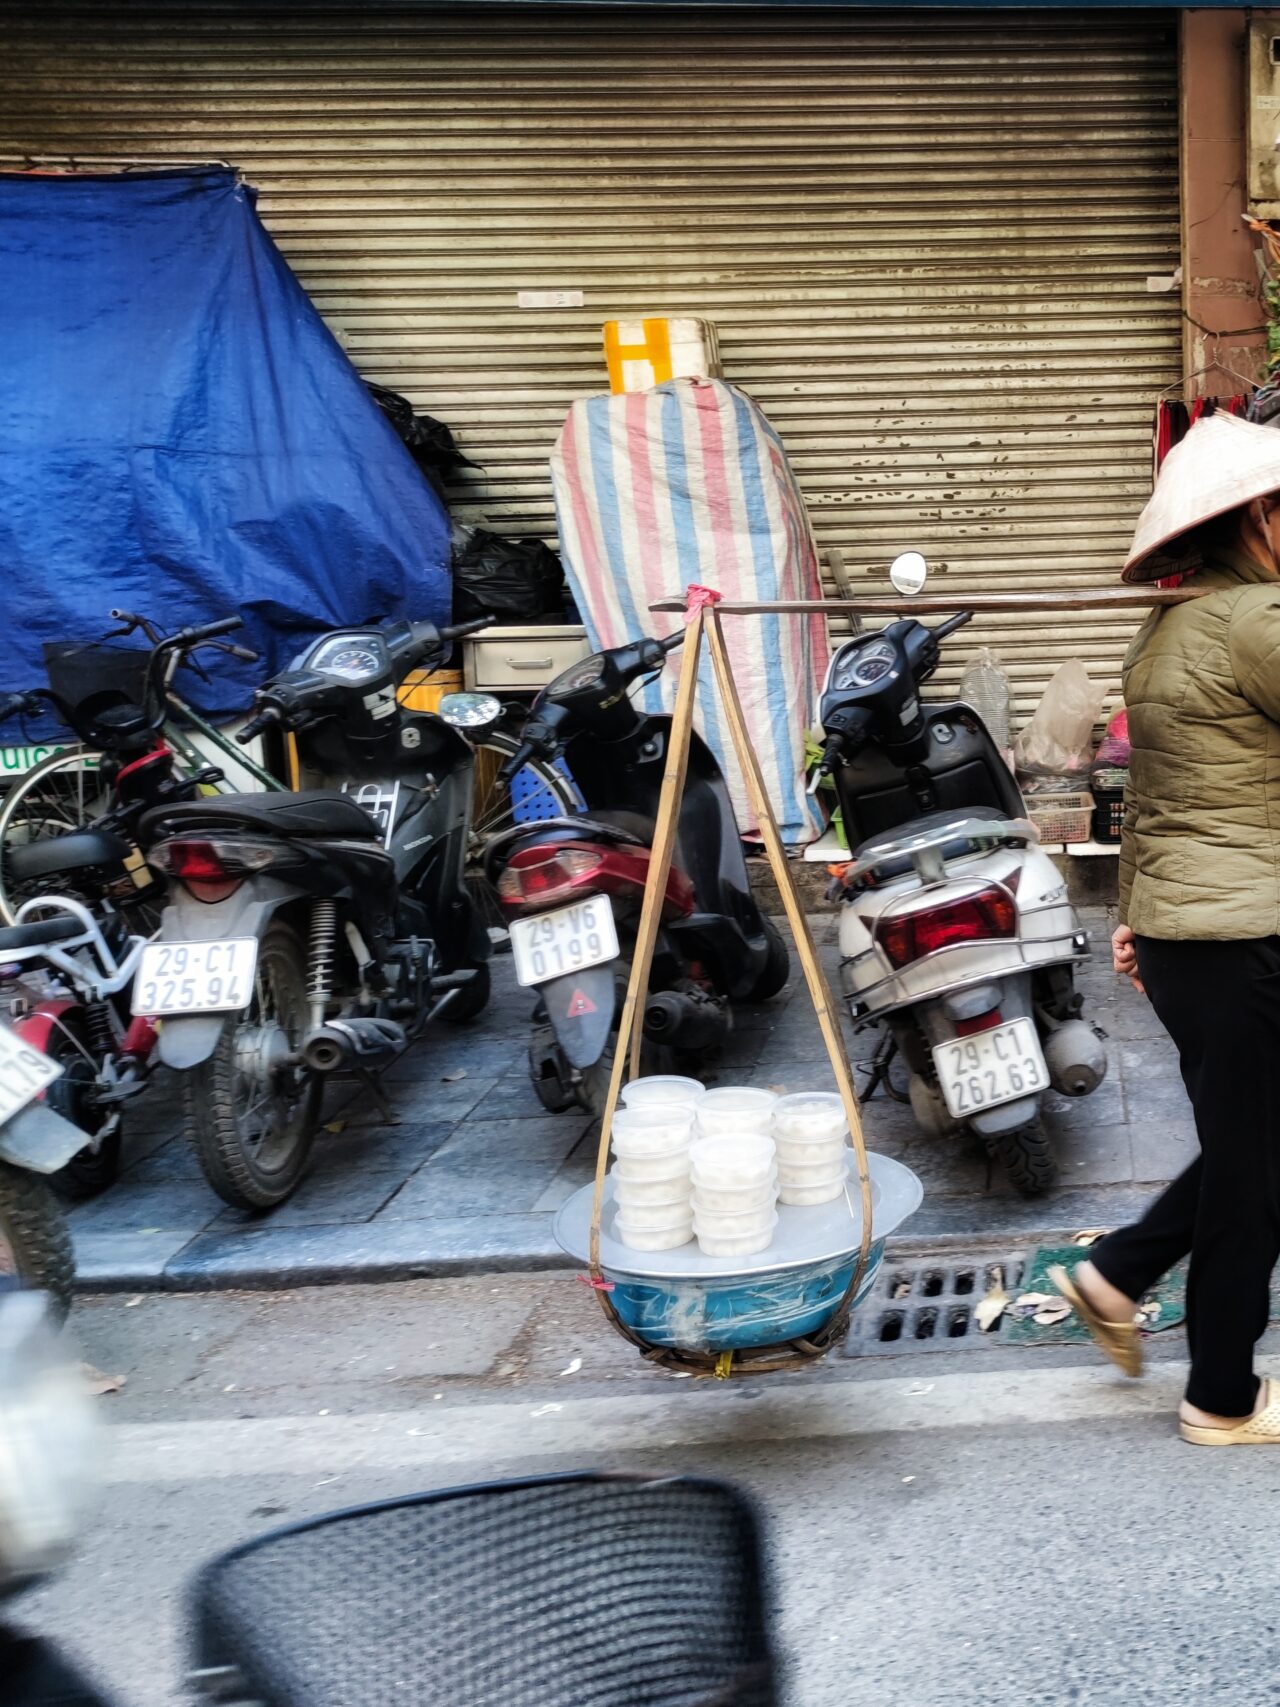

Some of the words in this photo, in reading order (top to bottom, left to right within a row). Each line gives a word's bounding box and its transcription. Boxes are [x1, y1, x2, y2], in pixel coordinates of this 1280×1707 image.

[528, 904, 596, 948] 29-V6
[532, 932, 603, 977] 0199
[142, 975, 242, 1011] 325.94
[950, 1026, 1023, 1076] 29-C1
[951, 1057, 1041, 1111] 262.63
